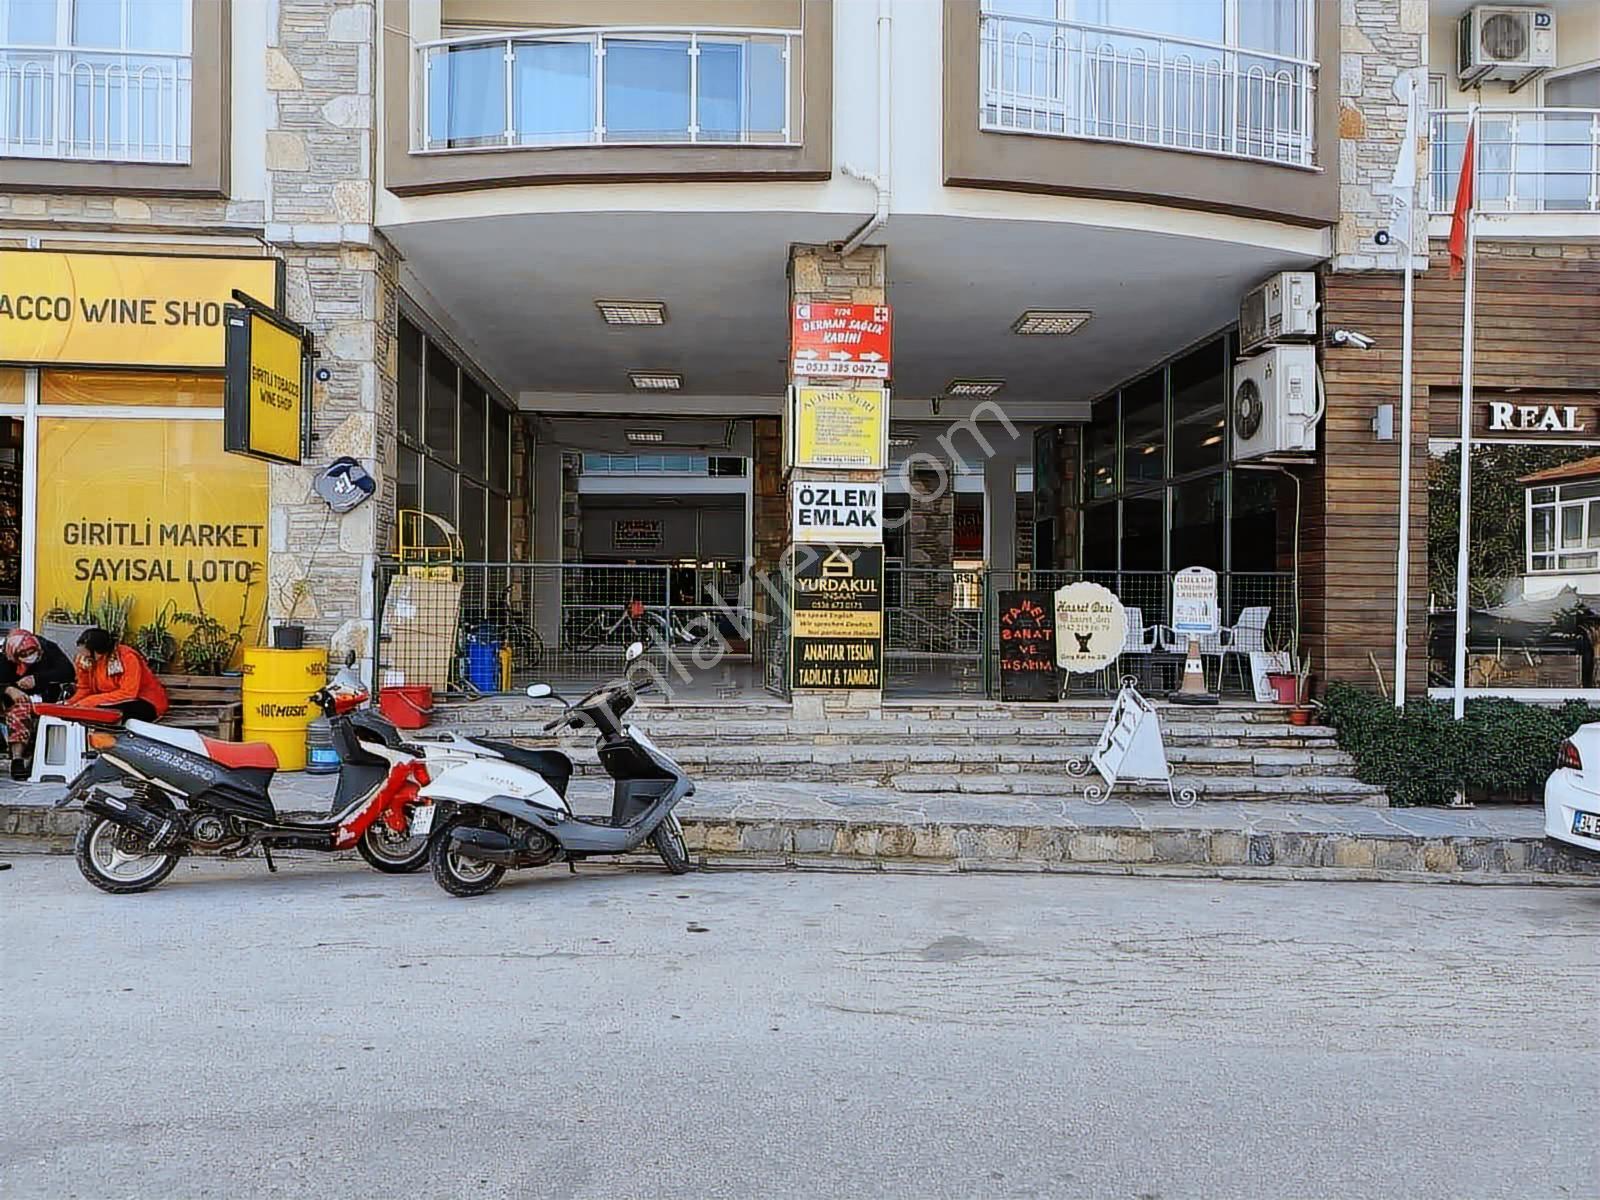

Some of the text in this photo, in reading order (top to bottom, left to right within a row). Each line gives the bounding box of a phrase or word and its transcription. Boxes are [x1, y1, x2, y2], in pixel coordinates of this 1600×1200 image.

[80, 298, 157, 325] WINE
[1489, 401, 1585, 432] REAL
[799, 484, 877, 507] ÖZLEM
[799, 509, 877, 527] EMLAK
[64, 517, 264, 548] GİRİTLİ MARKET
[75, 558, 251, 583] SAYISAL LOTO
[798, 578, 878, 593] YURDAKUL
[1002, 629, 1053, 640] SANAT
[803, 639, 875, 661] ANAHTAR TESLİM
[1019, 644, 1038, 654] VE
[799, 663, 832, 686] TADİLAT
[843, 663, 879, 686] TAMİRAT
